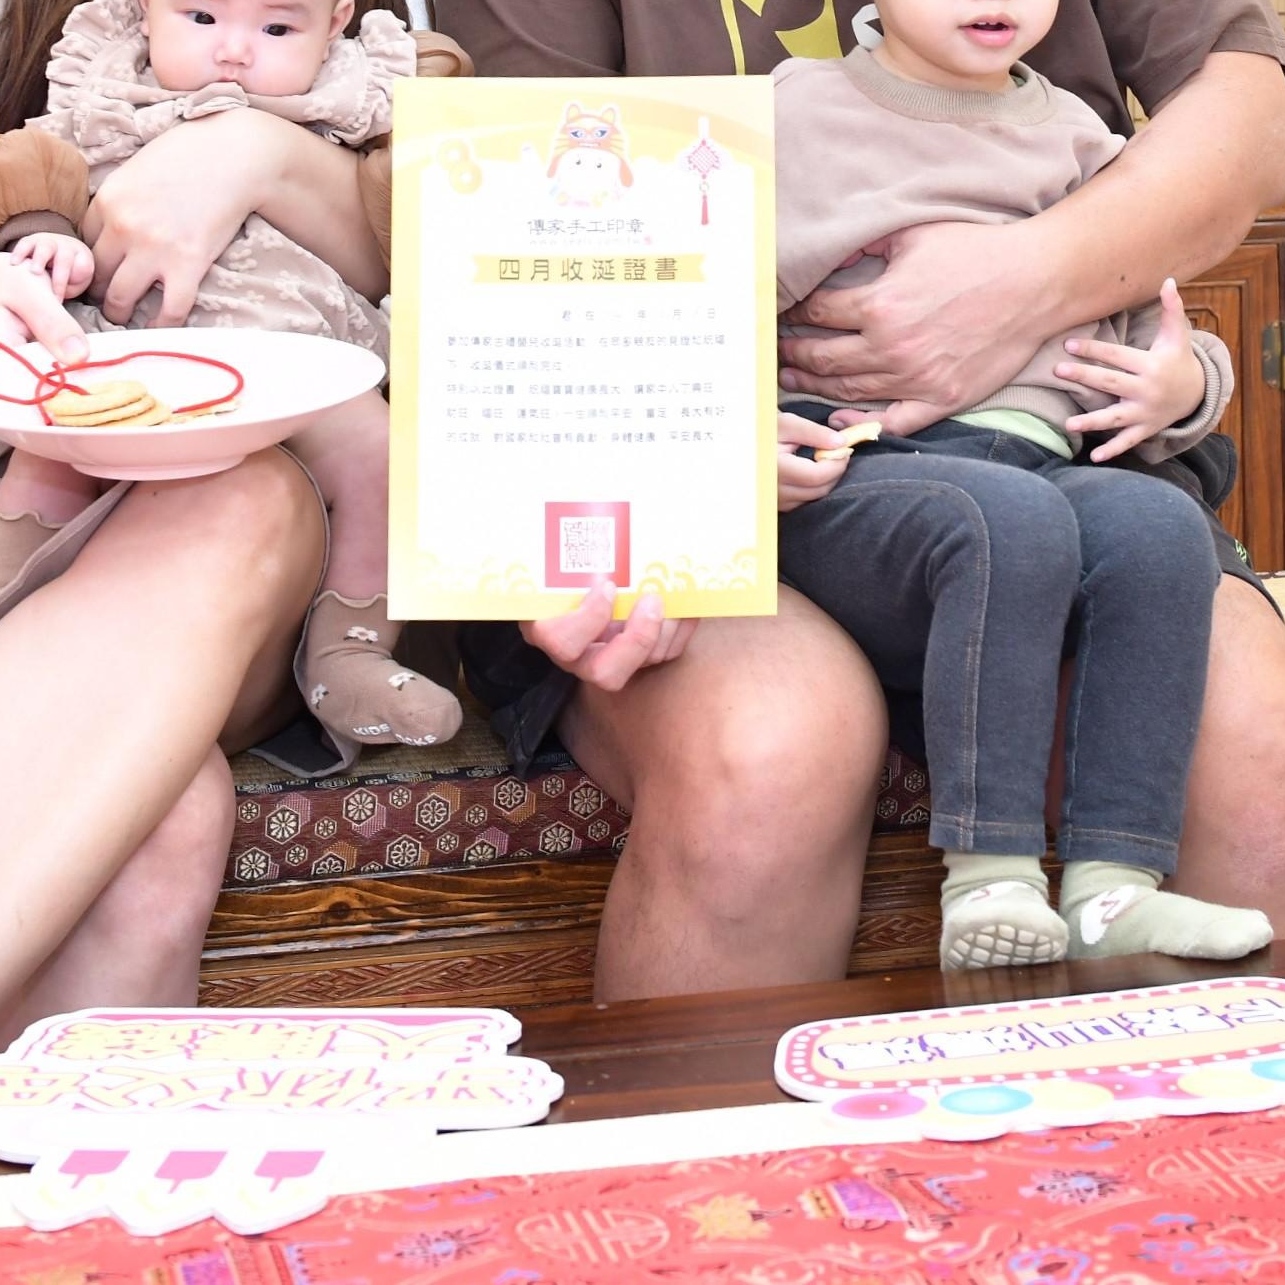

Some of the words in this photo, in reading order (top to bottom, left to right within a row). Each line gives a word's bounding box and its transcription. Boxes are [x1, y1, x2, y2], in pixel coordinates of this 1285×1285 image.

[526, 217, 646, 237] 傳家手工印章
[498, 257, 680, 283] 四月收涎證書
